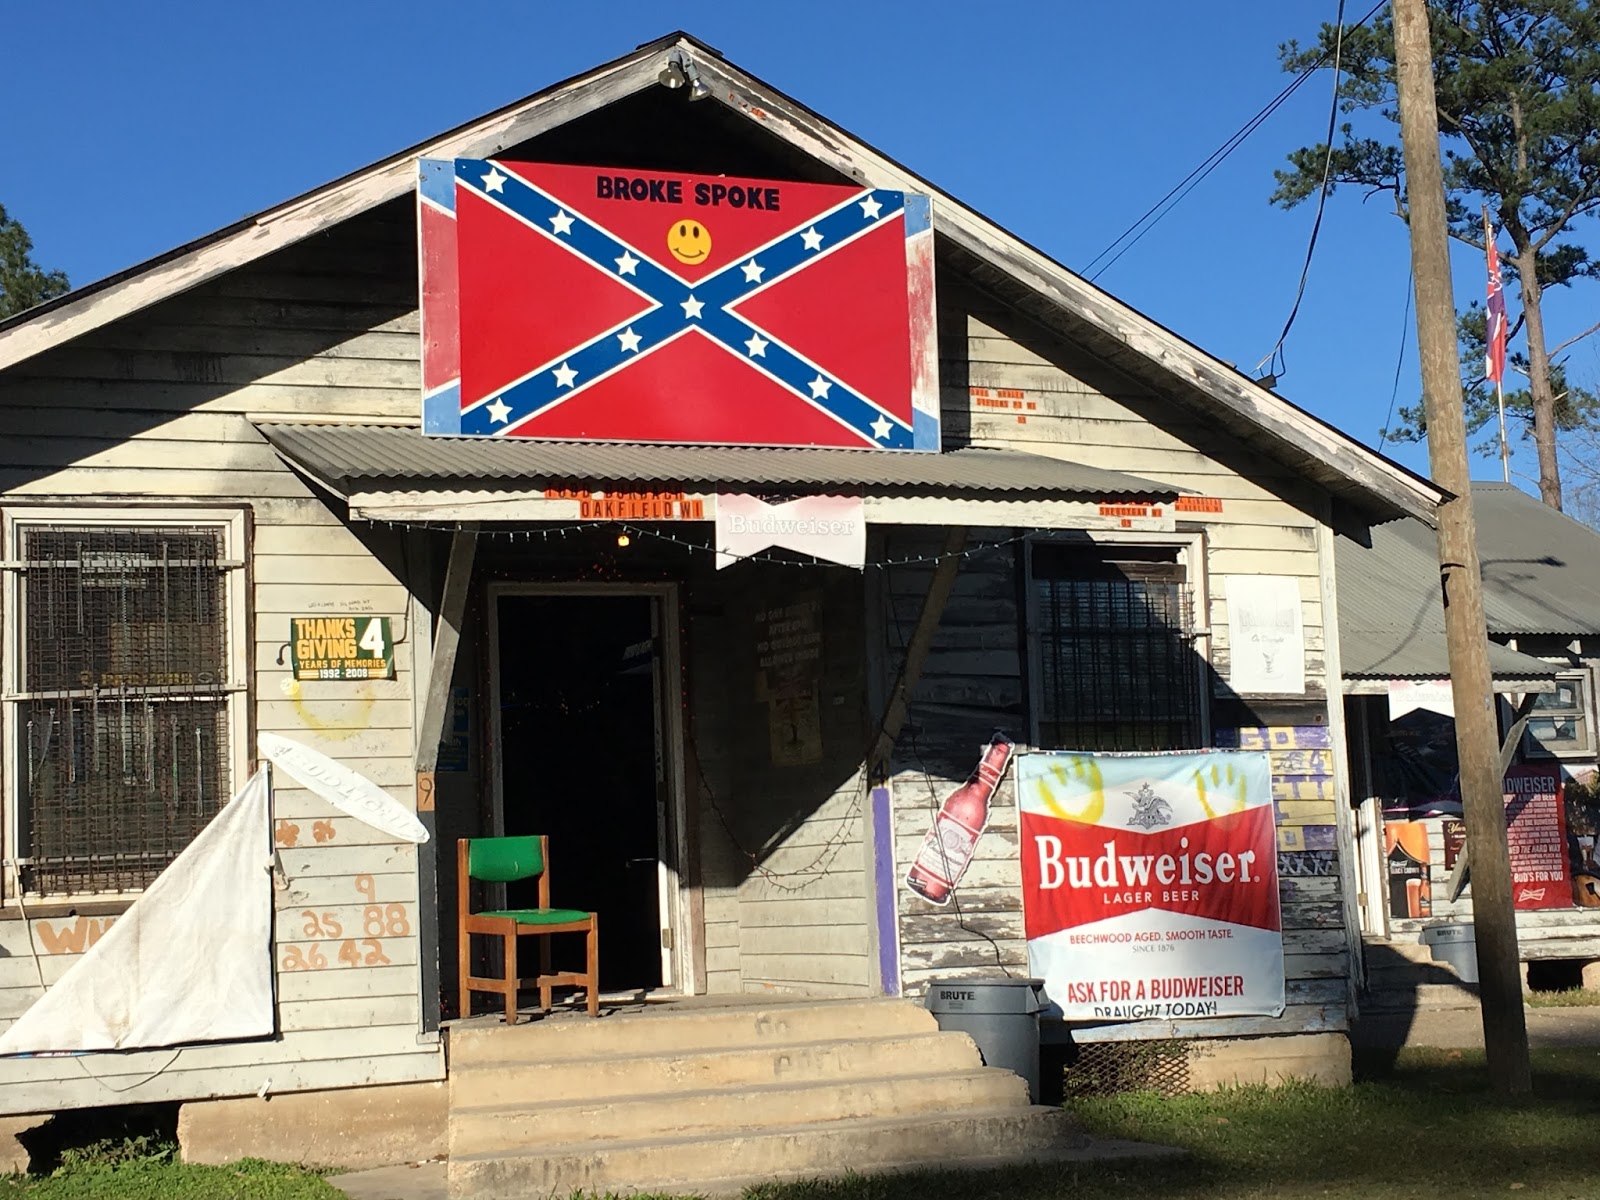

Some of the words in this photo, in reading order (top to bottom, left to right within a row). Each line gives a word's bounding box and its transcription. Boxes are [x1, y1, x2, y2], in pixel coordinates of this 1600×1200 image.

[597, 176, 683, 204] BROKE
[695, 183, 780, 211] SPOKE
[581, 501, 673, 518] OAKFIELD
[680, 502, 700, 518] WI
[728, 514, 855, 535] Budweiser
[295, 618, 356, 639] THANKS
[359, 617, 385, 659] 4
[296, 639, 357, 659] GIVING
[299, 660, 328, 669] YEARS
[331, 660, 341, 668] OF
[344, 659, 386, 668] MEMORIES
[419, 777, 433, 806] 9
[1503, 776, 1556, 793] DWEISER
[1535, 871, 1549, 882] FOR
[1549, 871, 1563, 881] YOU
[355, 873, 376, 903] 9
[1103, 891, 1152, 905] LAGER
[1163, 890, 1200, 902] BEER
[302, 910, 343, 938] 25
[363, 902, 410, 937] 88
[1070, 932, 1132, 944] BEECHWOOD
[1166, 930, 1206, 941] SMOOTH
[282, 943, 328, 970] 26
[338, 938, 391, 967] 42
[1132, 945, 1155, 953] SINCE
[1157, 944, 1175, 952] 1876
[940, 990, 976, 1001] BRUTE
[1068, 981, 1098, 1003] ASK
[1100, 979, 1131, 1002] FOR
[1135, 979, 1146, 1000] A
[1150, 975, 1244, 1000] BUDWEISER
[1094, 1003, 1162, 1019] DRAUGHT
[1165, 1001, 1217, 1017] TODAY!
